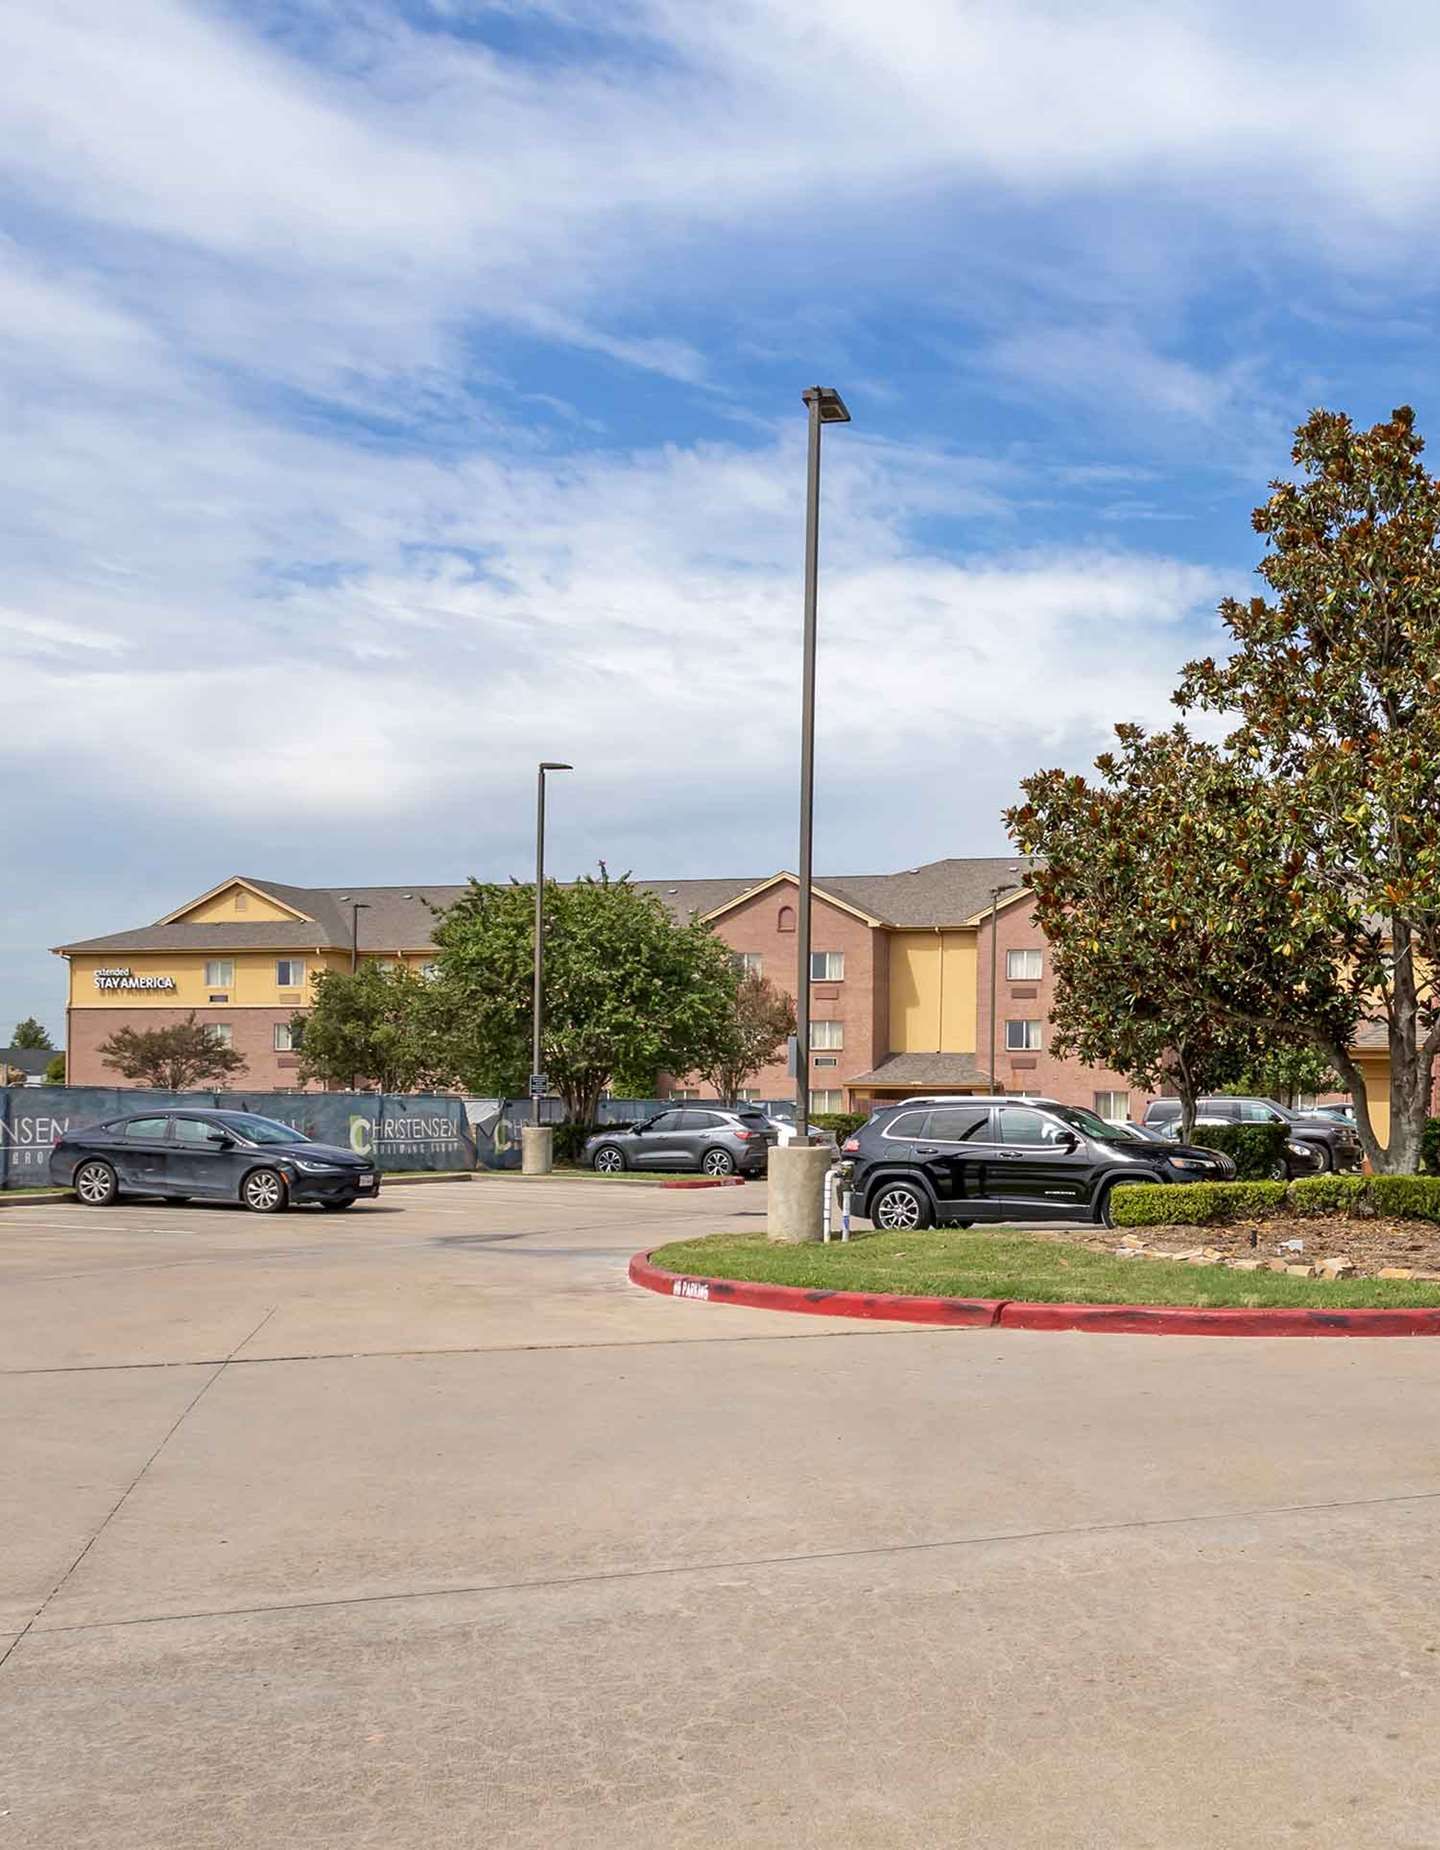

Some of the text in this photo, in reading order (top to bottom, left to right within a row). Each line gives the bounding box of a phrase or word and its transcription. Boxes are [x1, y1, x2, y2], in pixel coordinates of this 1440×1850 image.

[95, 967, 130, 977] extended
[350, 1117, 458, 1155] CHRISTENSEN
[682, 1281, 709, 1300] PARKING
